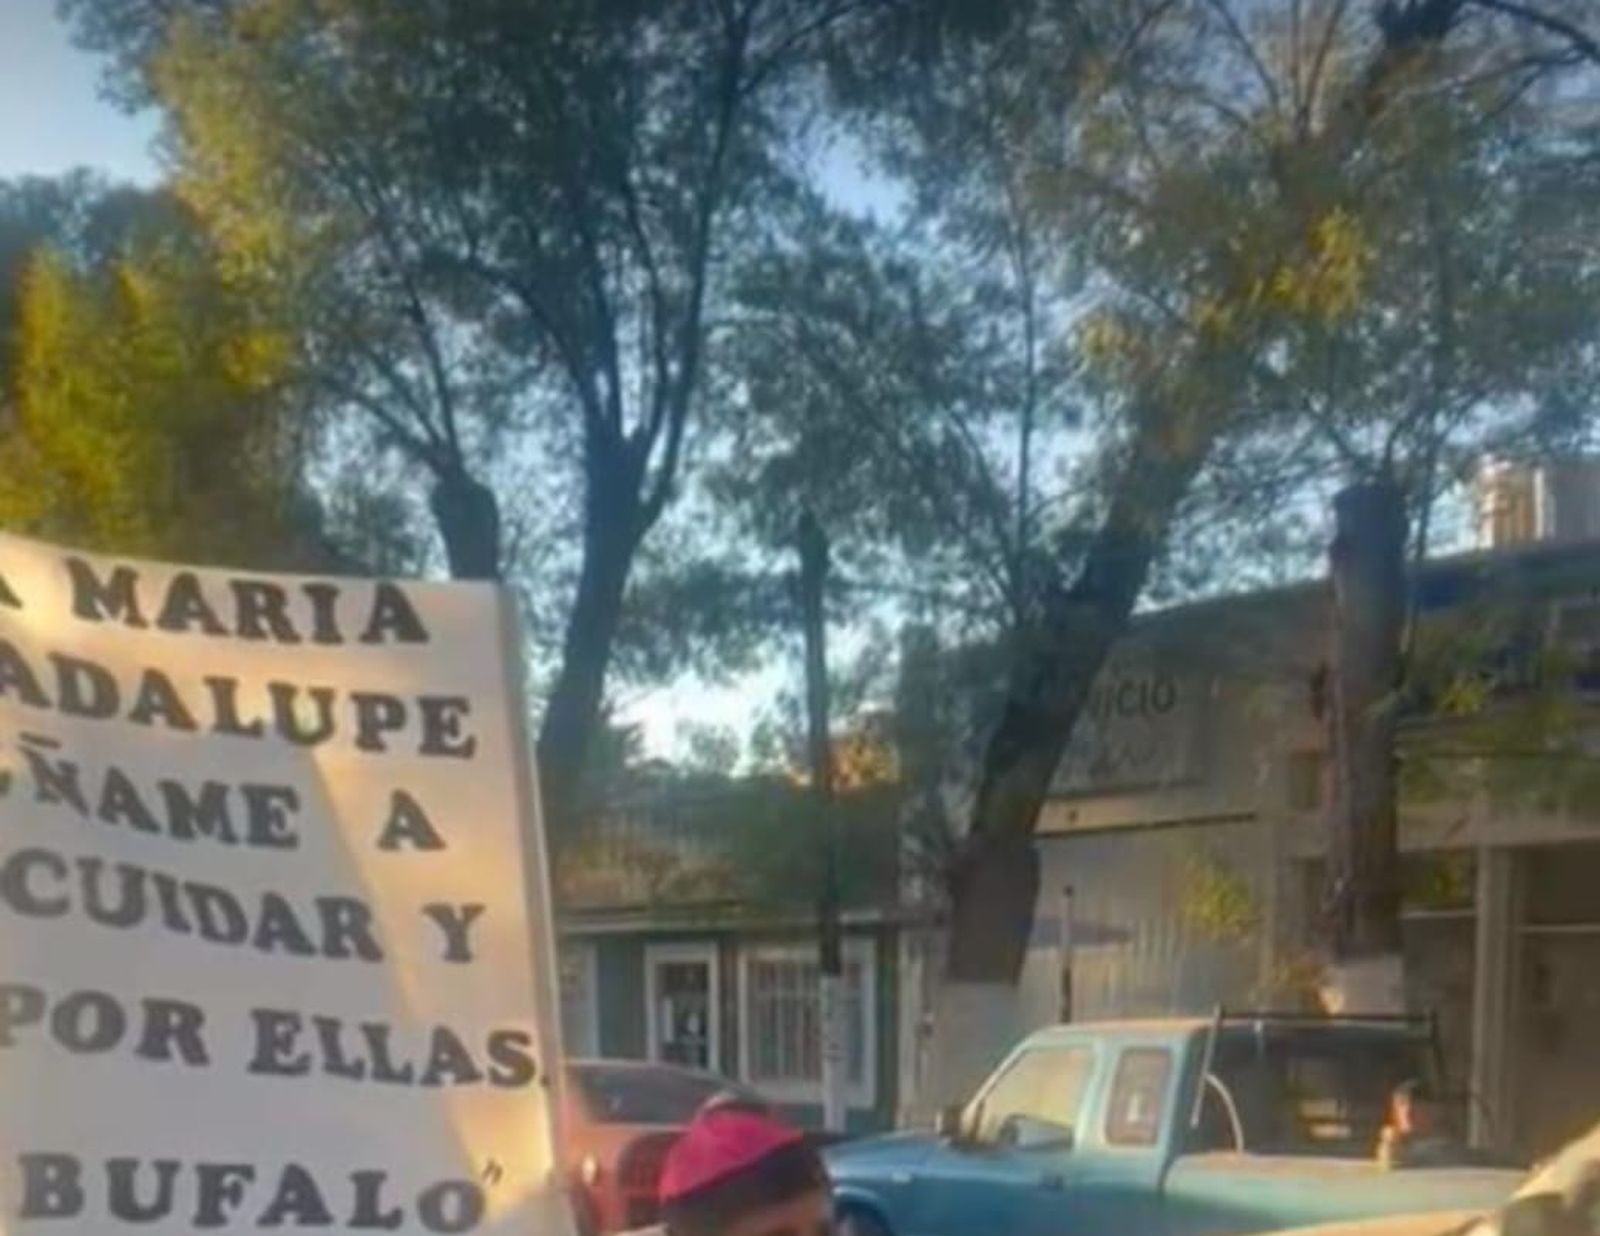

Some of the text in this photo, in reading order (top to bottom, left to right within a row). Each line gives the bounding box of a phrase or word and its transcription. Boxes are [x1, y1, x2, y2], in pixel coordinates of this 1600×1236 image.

[65, 556, 430, 645] MARIA
[0, 732, 446, 850] ÑAME A
[0, 849, 486, 963] CUIDAR Y
[0, 982, 210, 1067] POR
